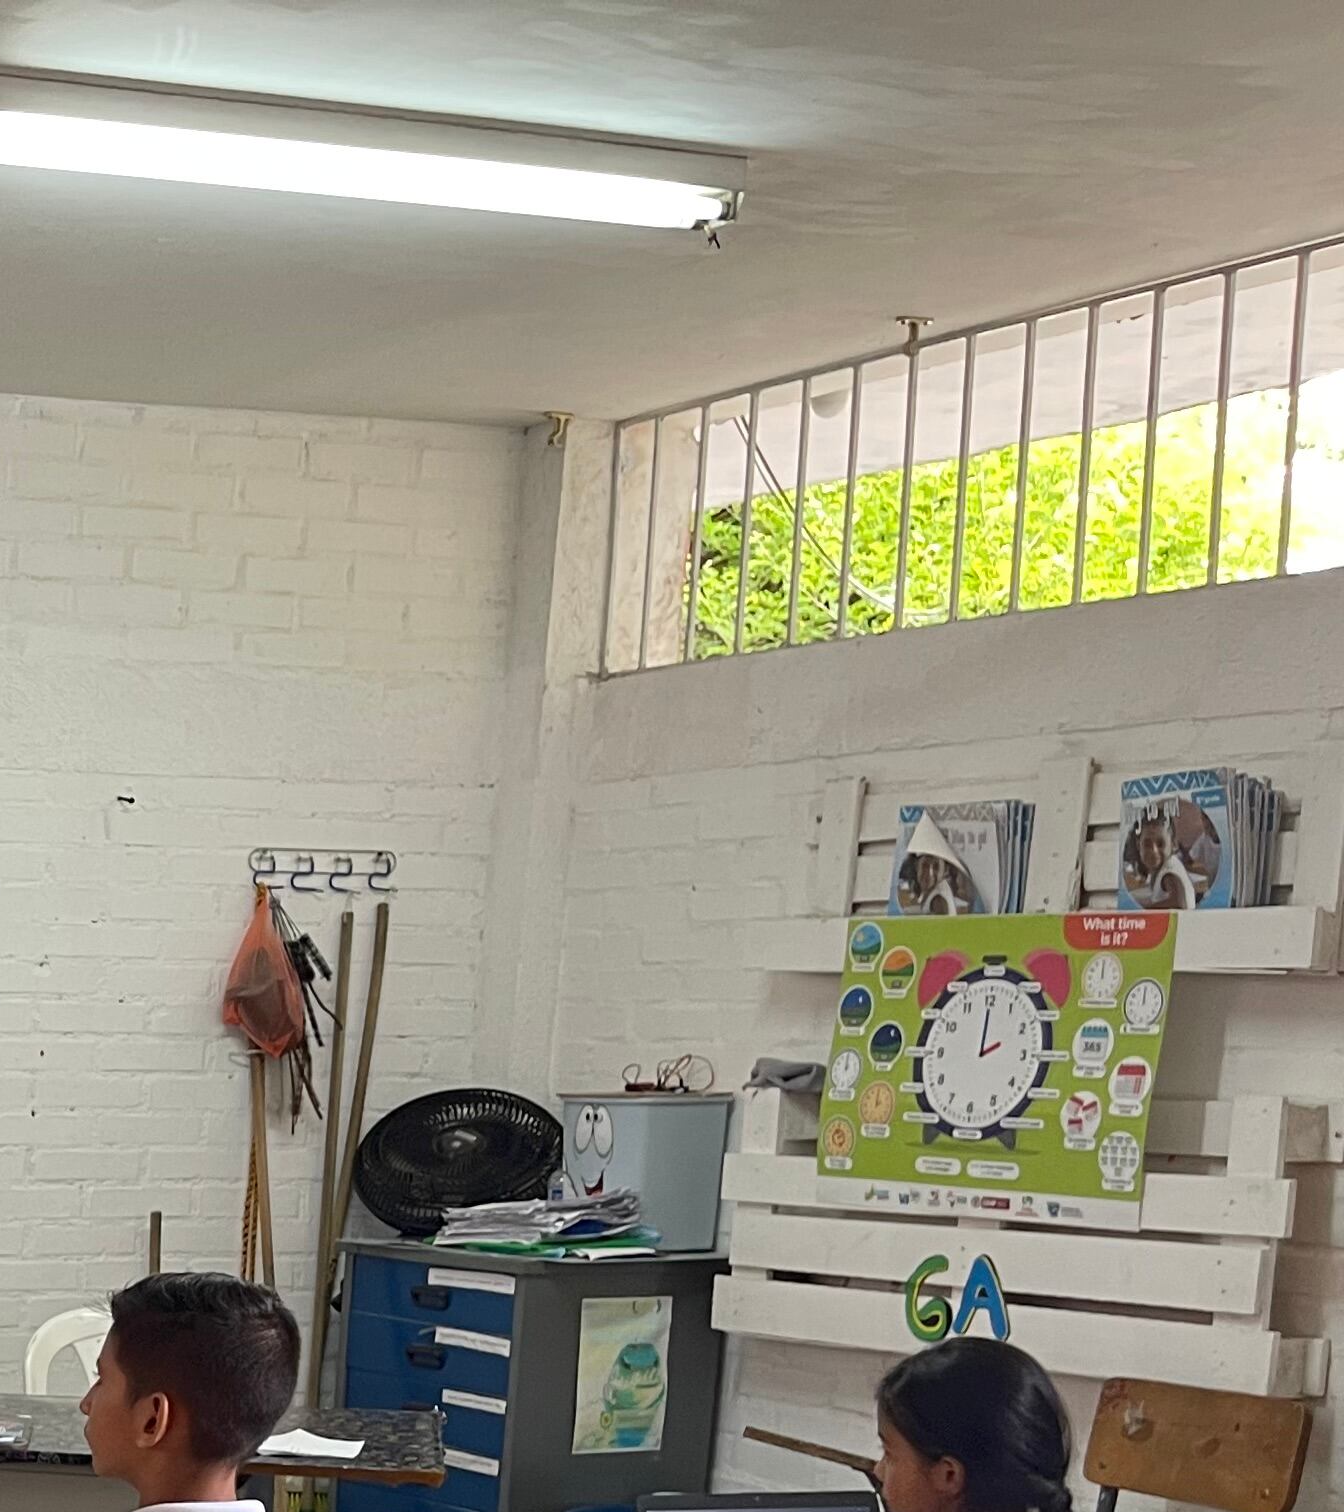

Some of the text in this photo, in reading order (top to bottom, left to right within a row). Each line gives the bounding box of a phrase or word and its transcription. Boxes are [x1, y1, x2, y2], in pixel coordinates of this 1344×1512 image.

[1083, 917, 1146, 931] What time
[1100, 931, 1129, 946] is it?
[1082, 1041, 1102, 1053] 365
